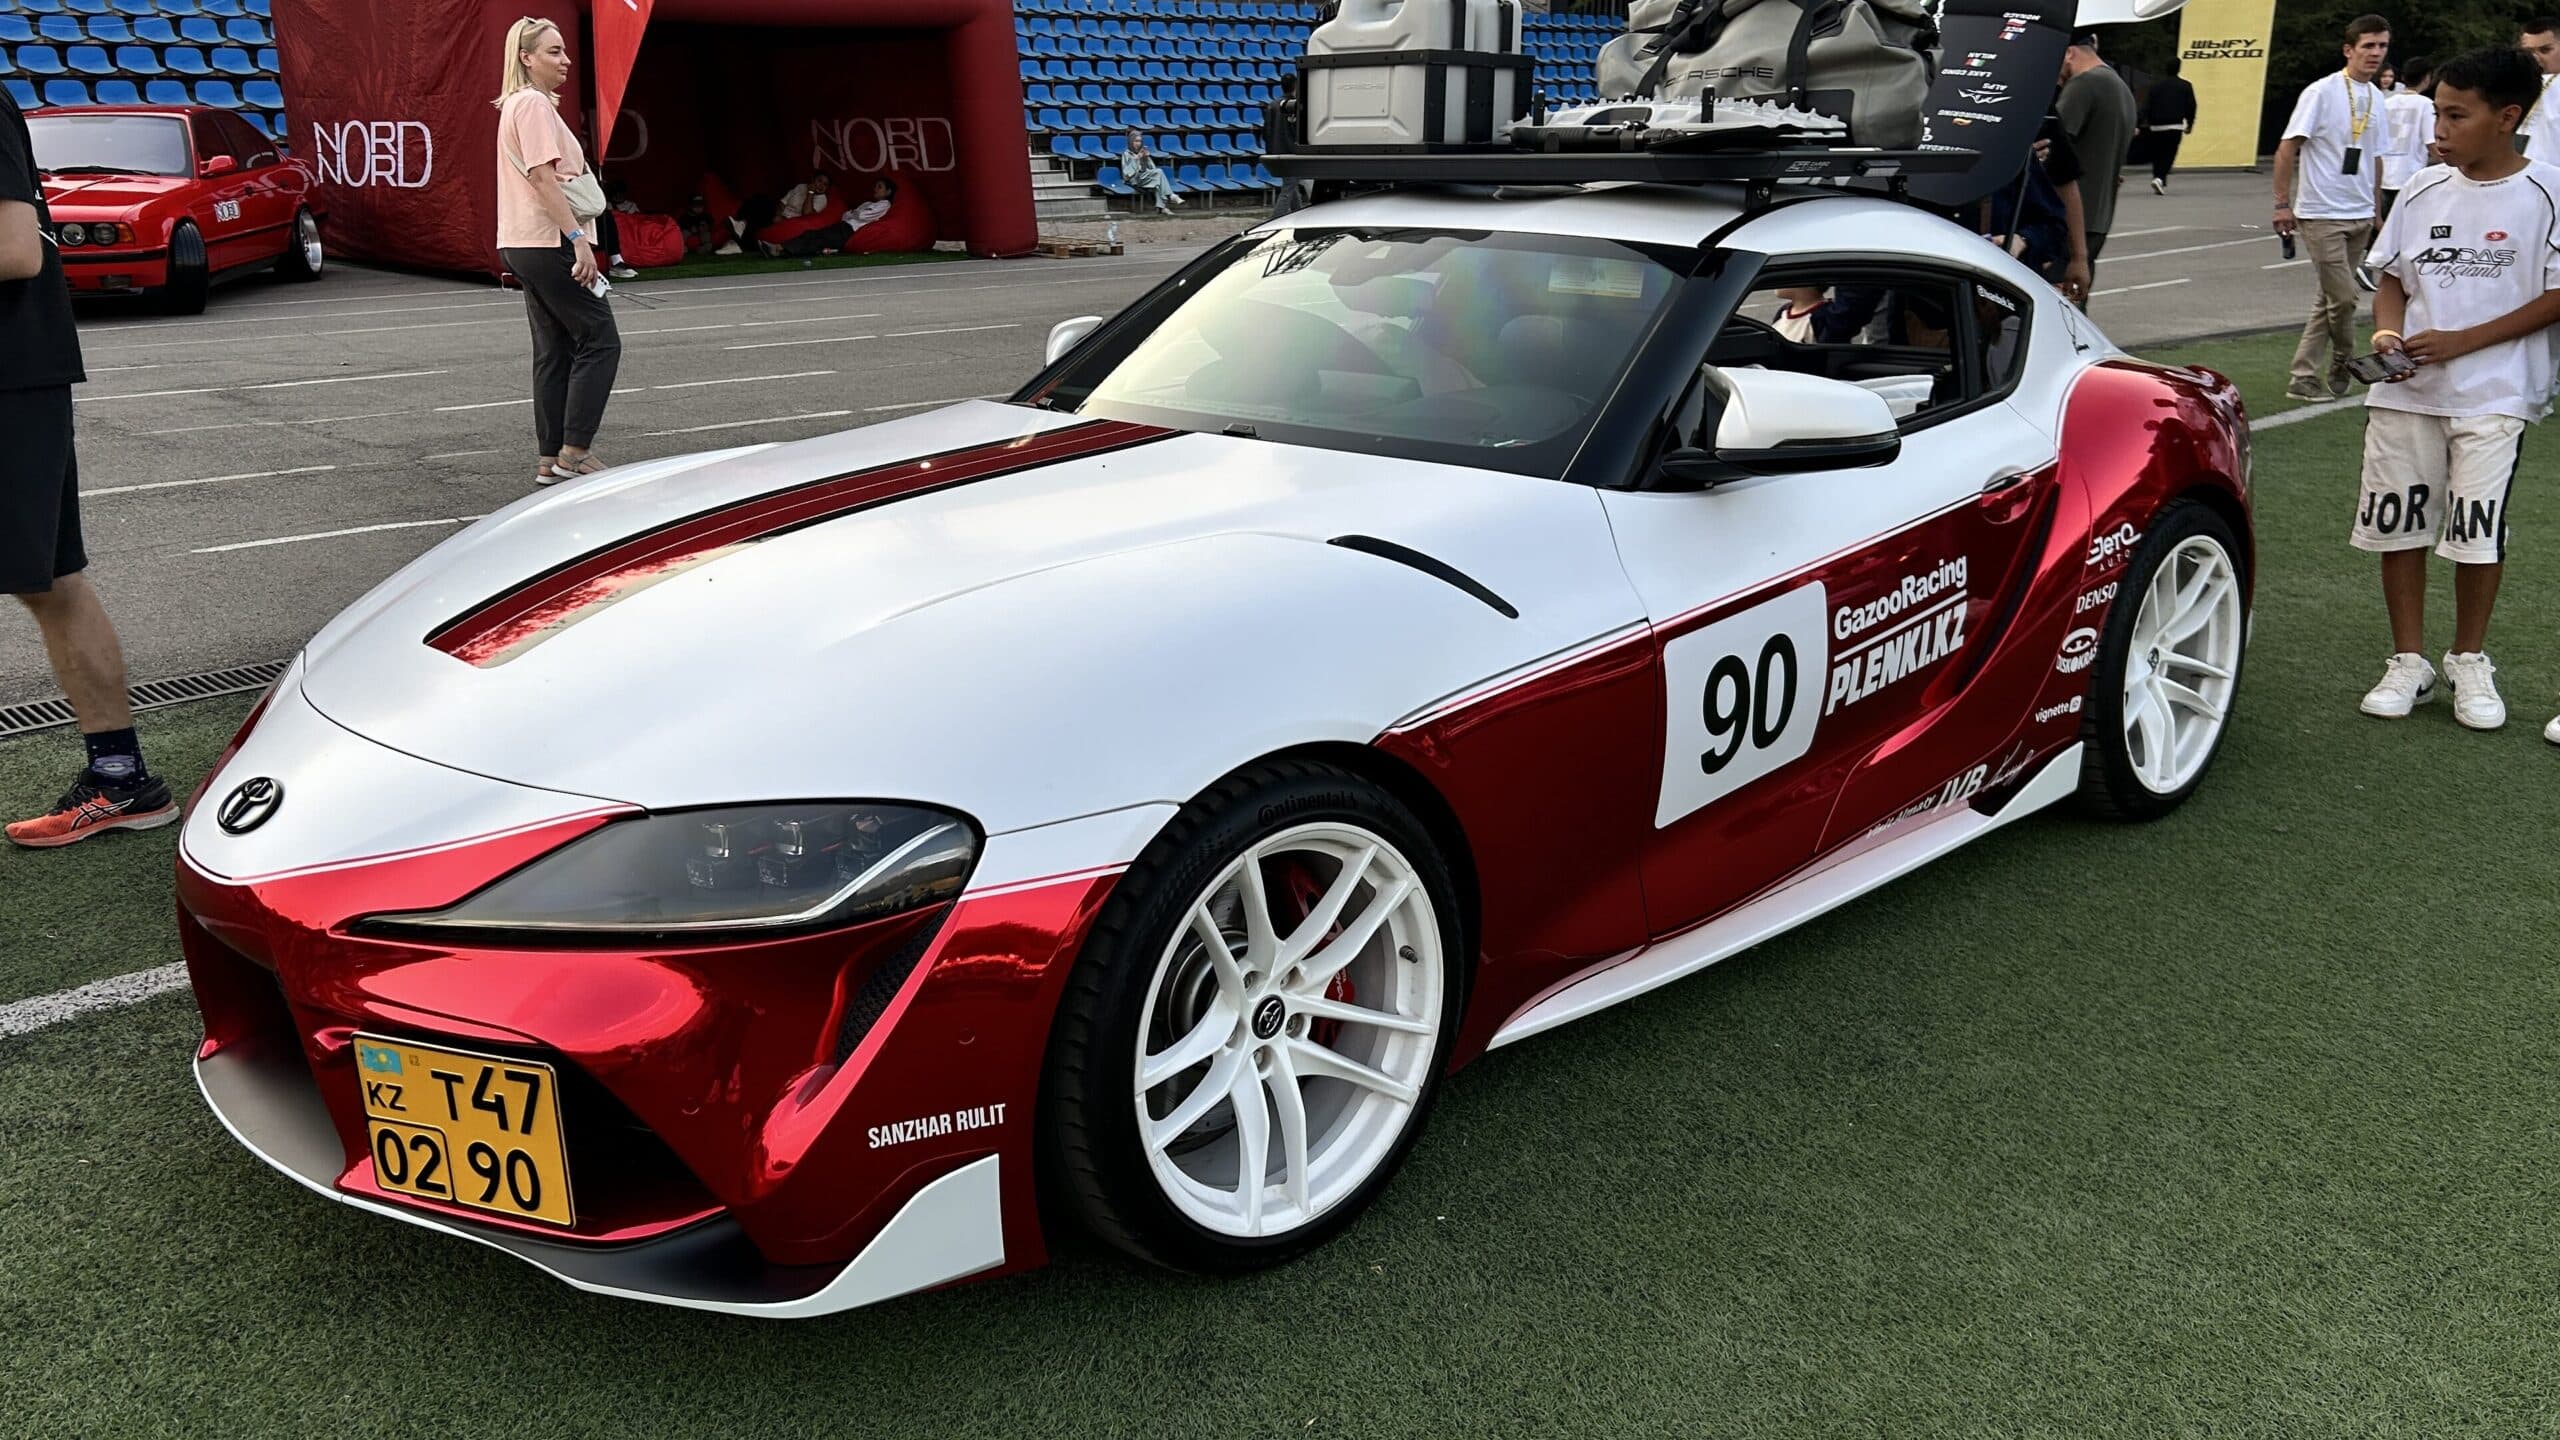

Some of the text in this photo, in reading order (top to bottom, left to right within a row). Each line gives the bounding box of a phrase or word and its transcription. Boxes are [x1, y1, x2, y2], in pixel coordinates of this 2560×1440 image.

[1982, 83, 2008, 91] ALPS
[2361, 483, 2496, 543] JORAN
[2099, 549, 2131, 572] AUTO
[1834, 555, 1967, 640] GazooRacing
[2075, 581, 2118, 614] DENSO
[1700, 633, 1798, 775] 90
[2035, 701, 2069, 723] vignette
[1257, 791, 1347, 826] Continental
[366, 1064, 542, 1136] KZ T47
[868, 1103, 1006, 1149] SANZHAR RULIT
[376, 1128, 541, 1212] 02 90
